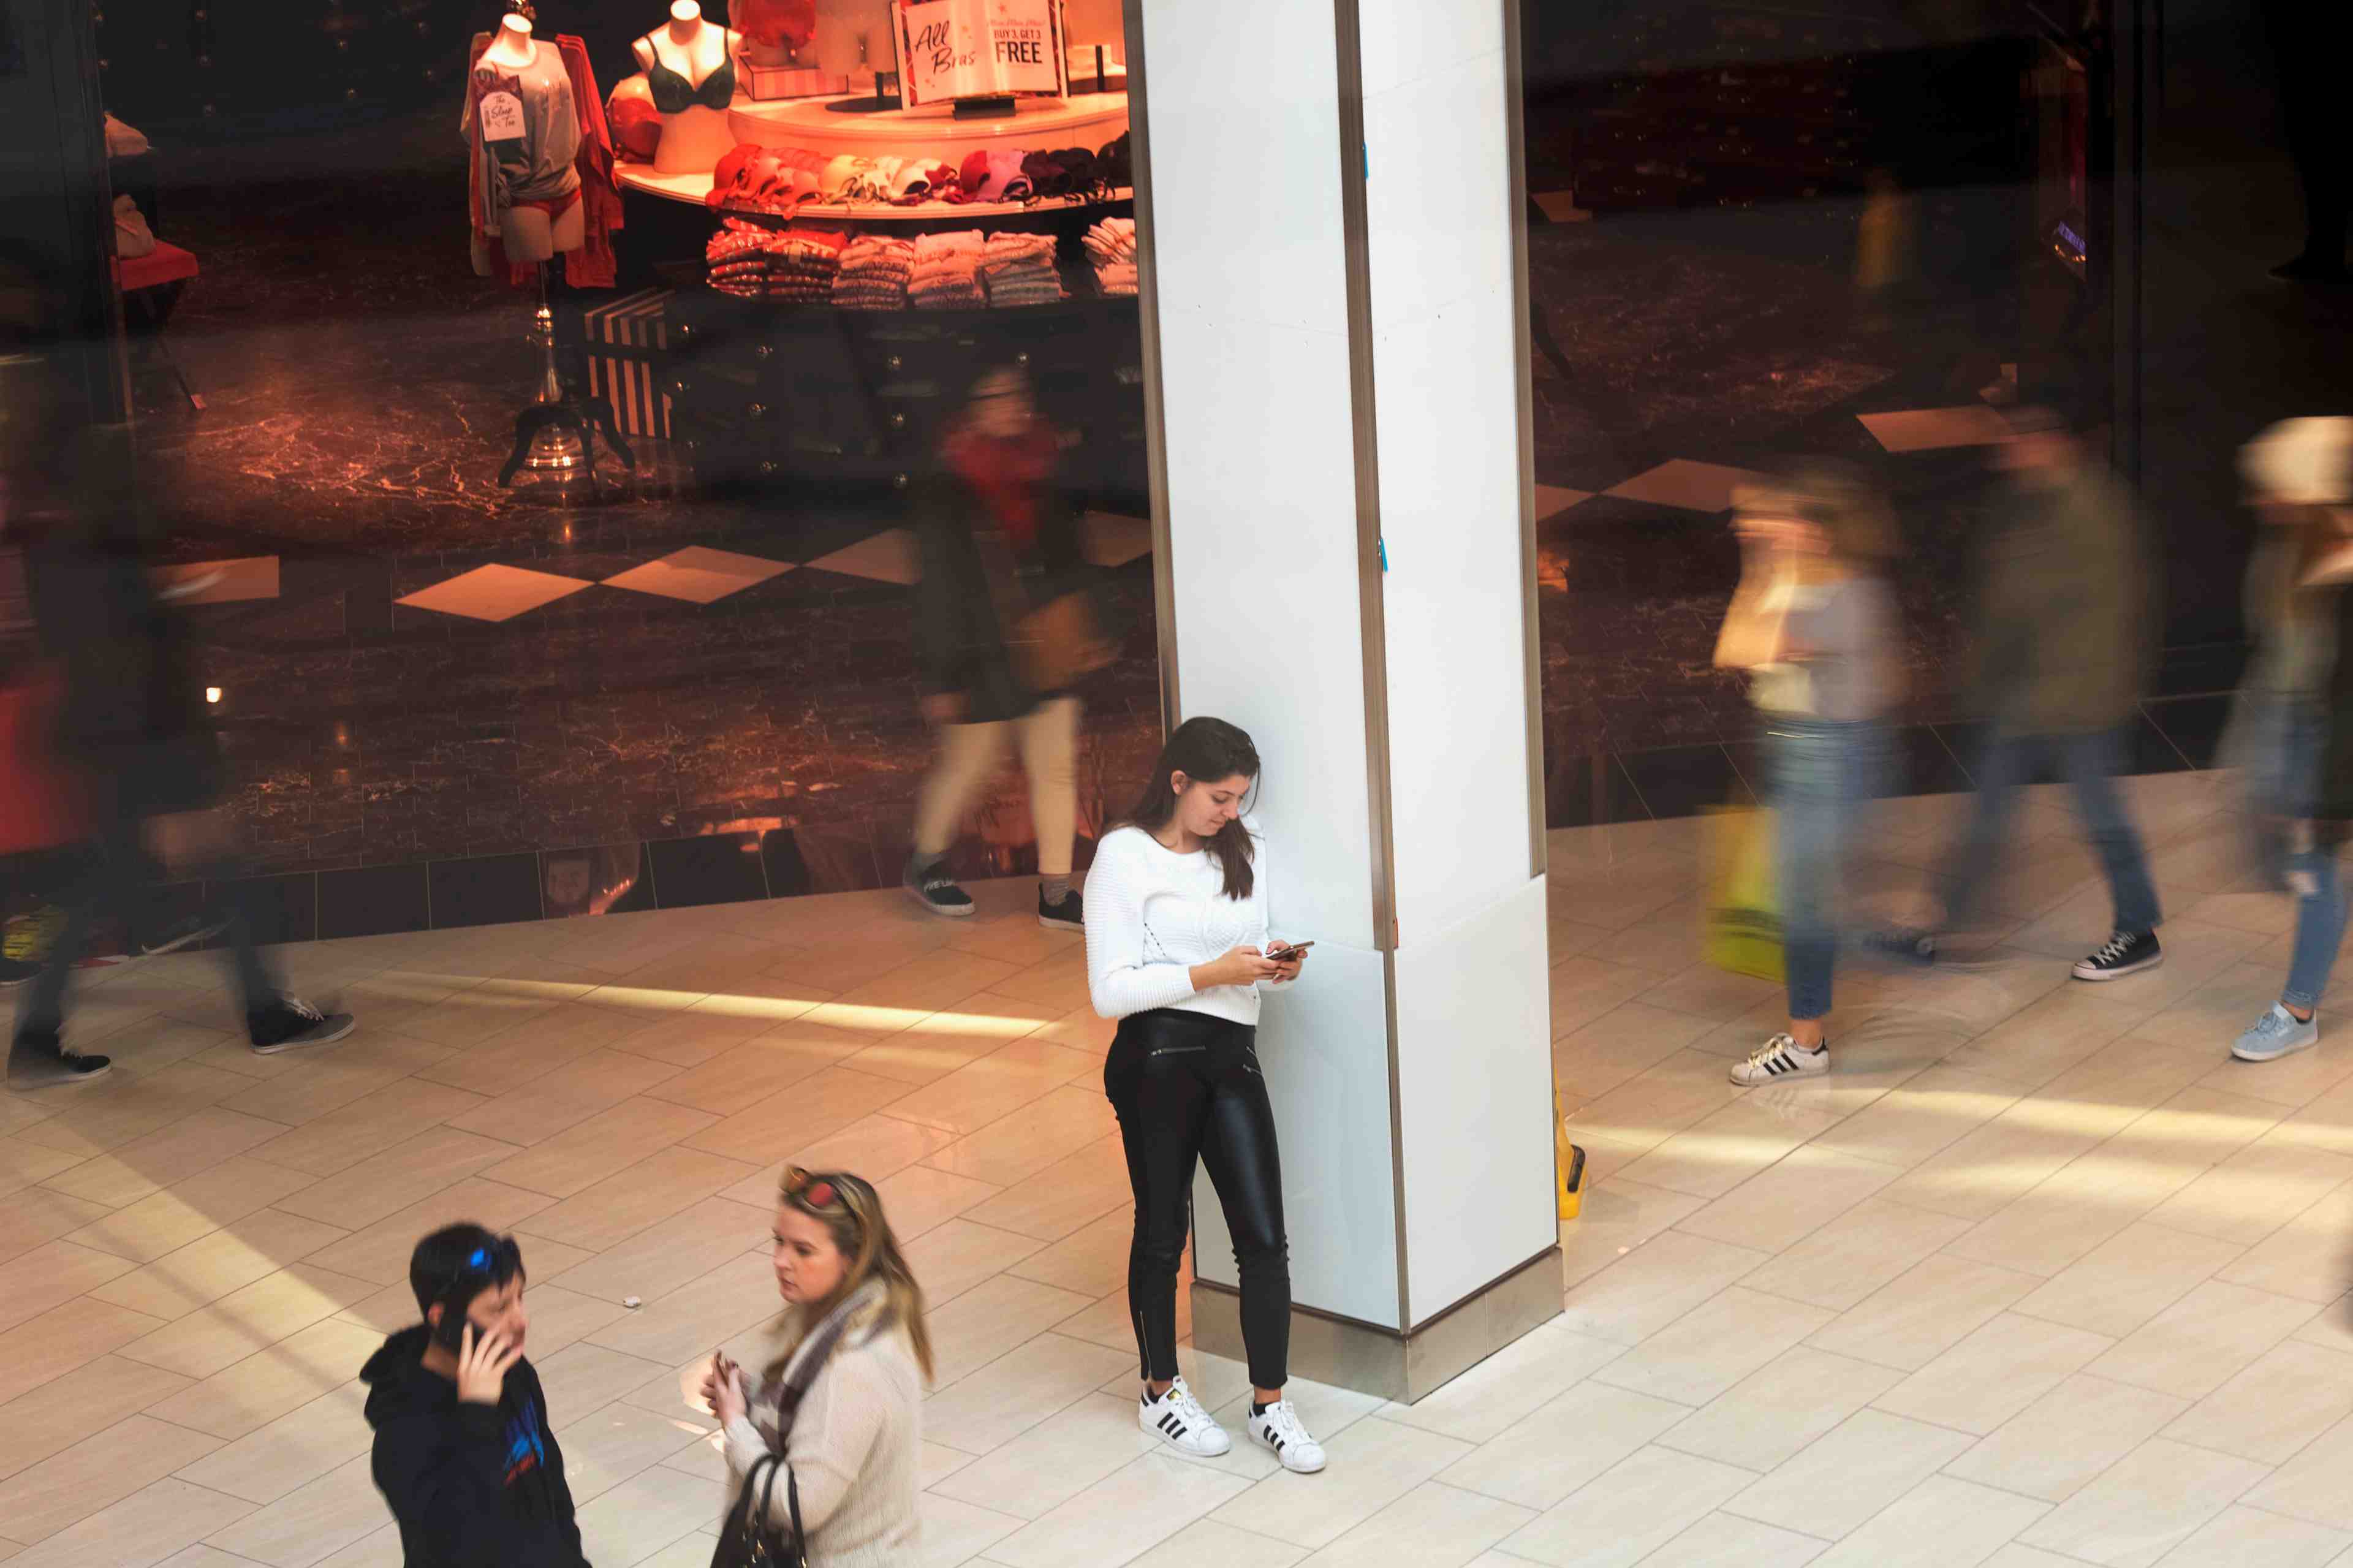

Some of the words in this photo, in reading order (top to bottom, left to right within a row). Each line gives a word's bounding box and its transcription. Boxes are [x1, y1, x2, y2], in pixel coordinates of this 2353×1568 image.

[915, 20, 950, 53] All
[994, 29, 1010, 39] BUY
[1020, 29, 1034, 39] GET
[931, 47, 976, 75] Bras
[995, 41, 1042, 63] FREE
